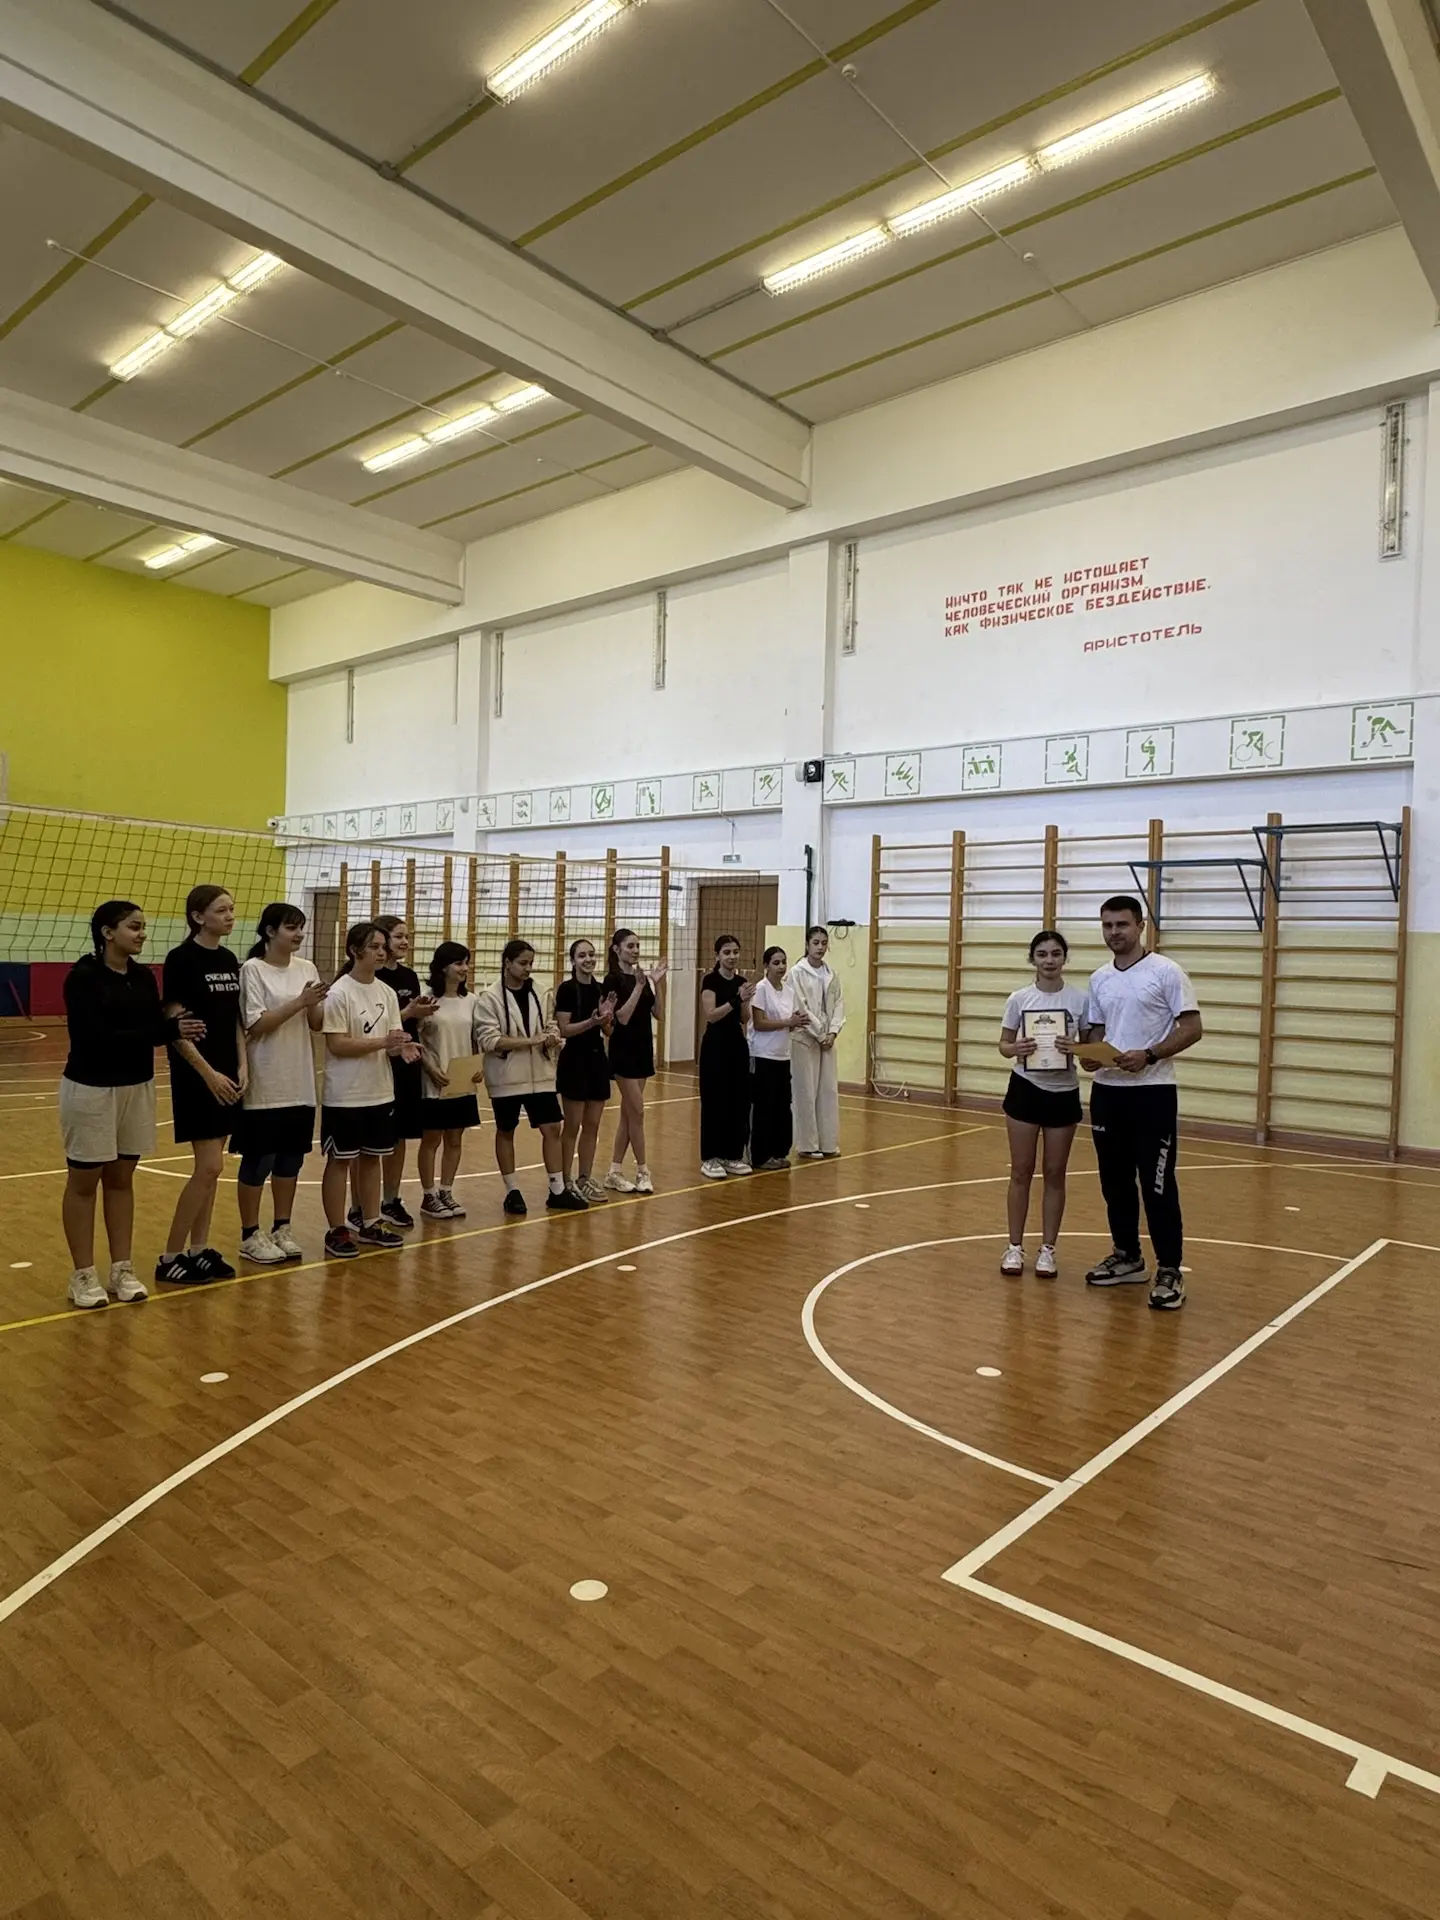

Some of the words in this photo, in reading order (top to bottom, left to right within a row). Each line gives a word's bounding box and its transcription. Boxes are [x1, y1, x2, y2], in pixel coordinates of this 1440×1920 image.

[945, 590, 988, 609] НИЧТО
[998, 583, 1024, 597] ТАК
[1034, 576, 1053, 590] НЕ
[1064, 556, 1150, 583] ИСТОЩАЕТ
[945, 591, 1052, 623] ЧЕЛОВЕЧЕСКИЙ
[1061, 574, 1144, 600] ОРГАНИЗМ
[945, 623, 969, 637] КАК
[979, 602, 1074, 630] ФИЗИЧЕСКОЕ
[1085, 578, 1212, 611] БЕЗДЕЙСТВИЕ.
[1083, 623, 1203, 653] АРИСТОТЕЛЬ
